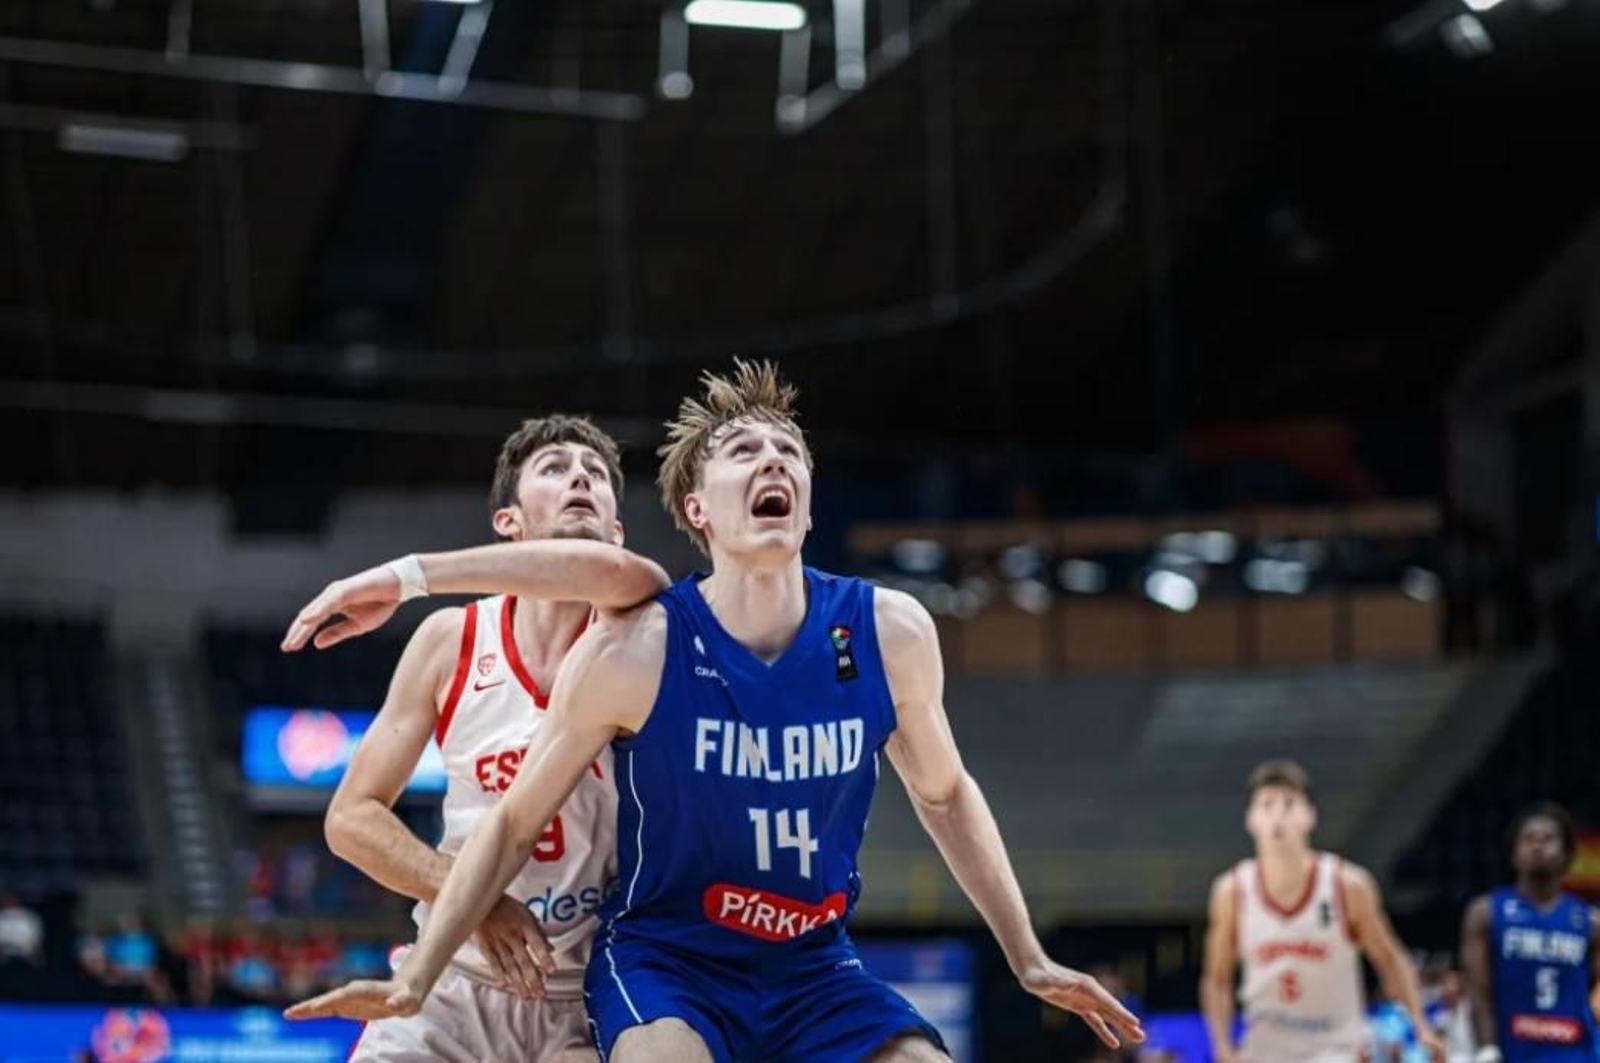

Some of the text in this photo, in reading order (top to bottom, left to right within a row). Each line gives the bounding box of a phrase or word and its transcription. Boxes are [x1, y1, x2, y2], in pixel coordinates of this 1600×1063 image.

[695, 717, 864, 782] FINLAND
[748, 808, 819, 879] 14
[1536, 967, 1558, 1009] 5
